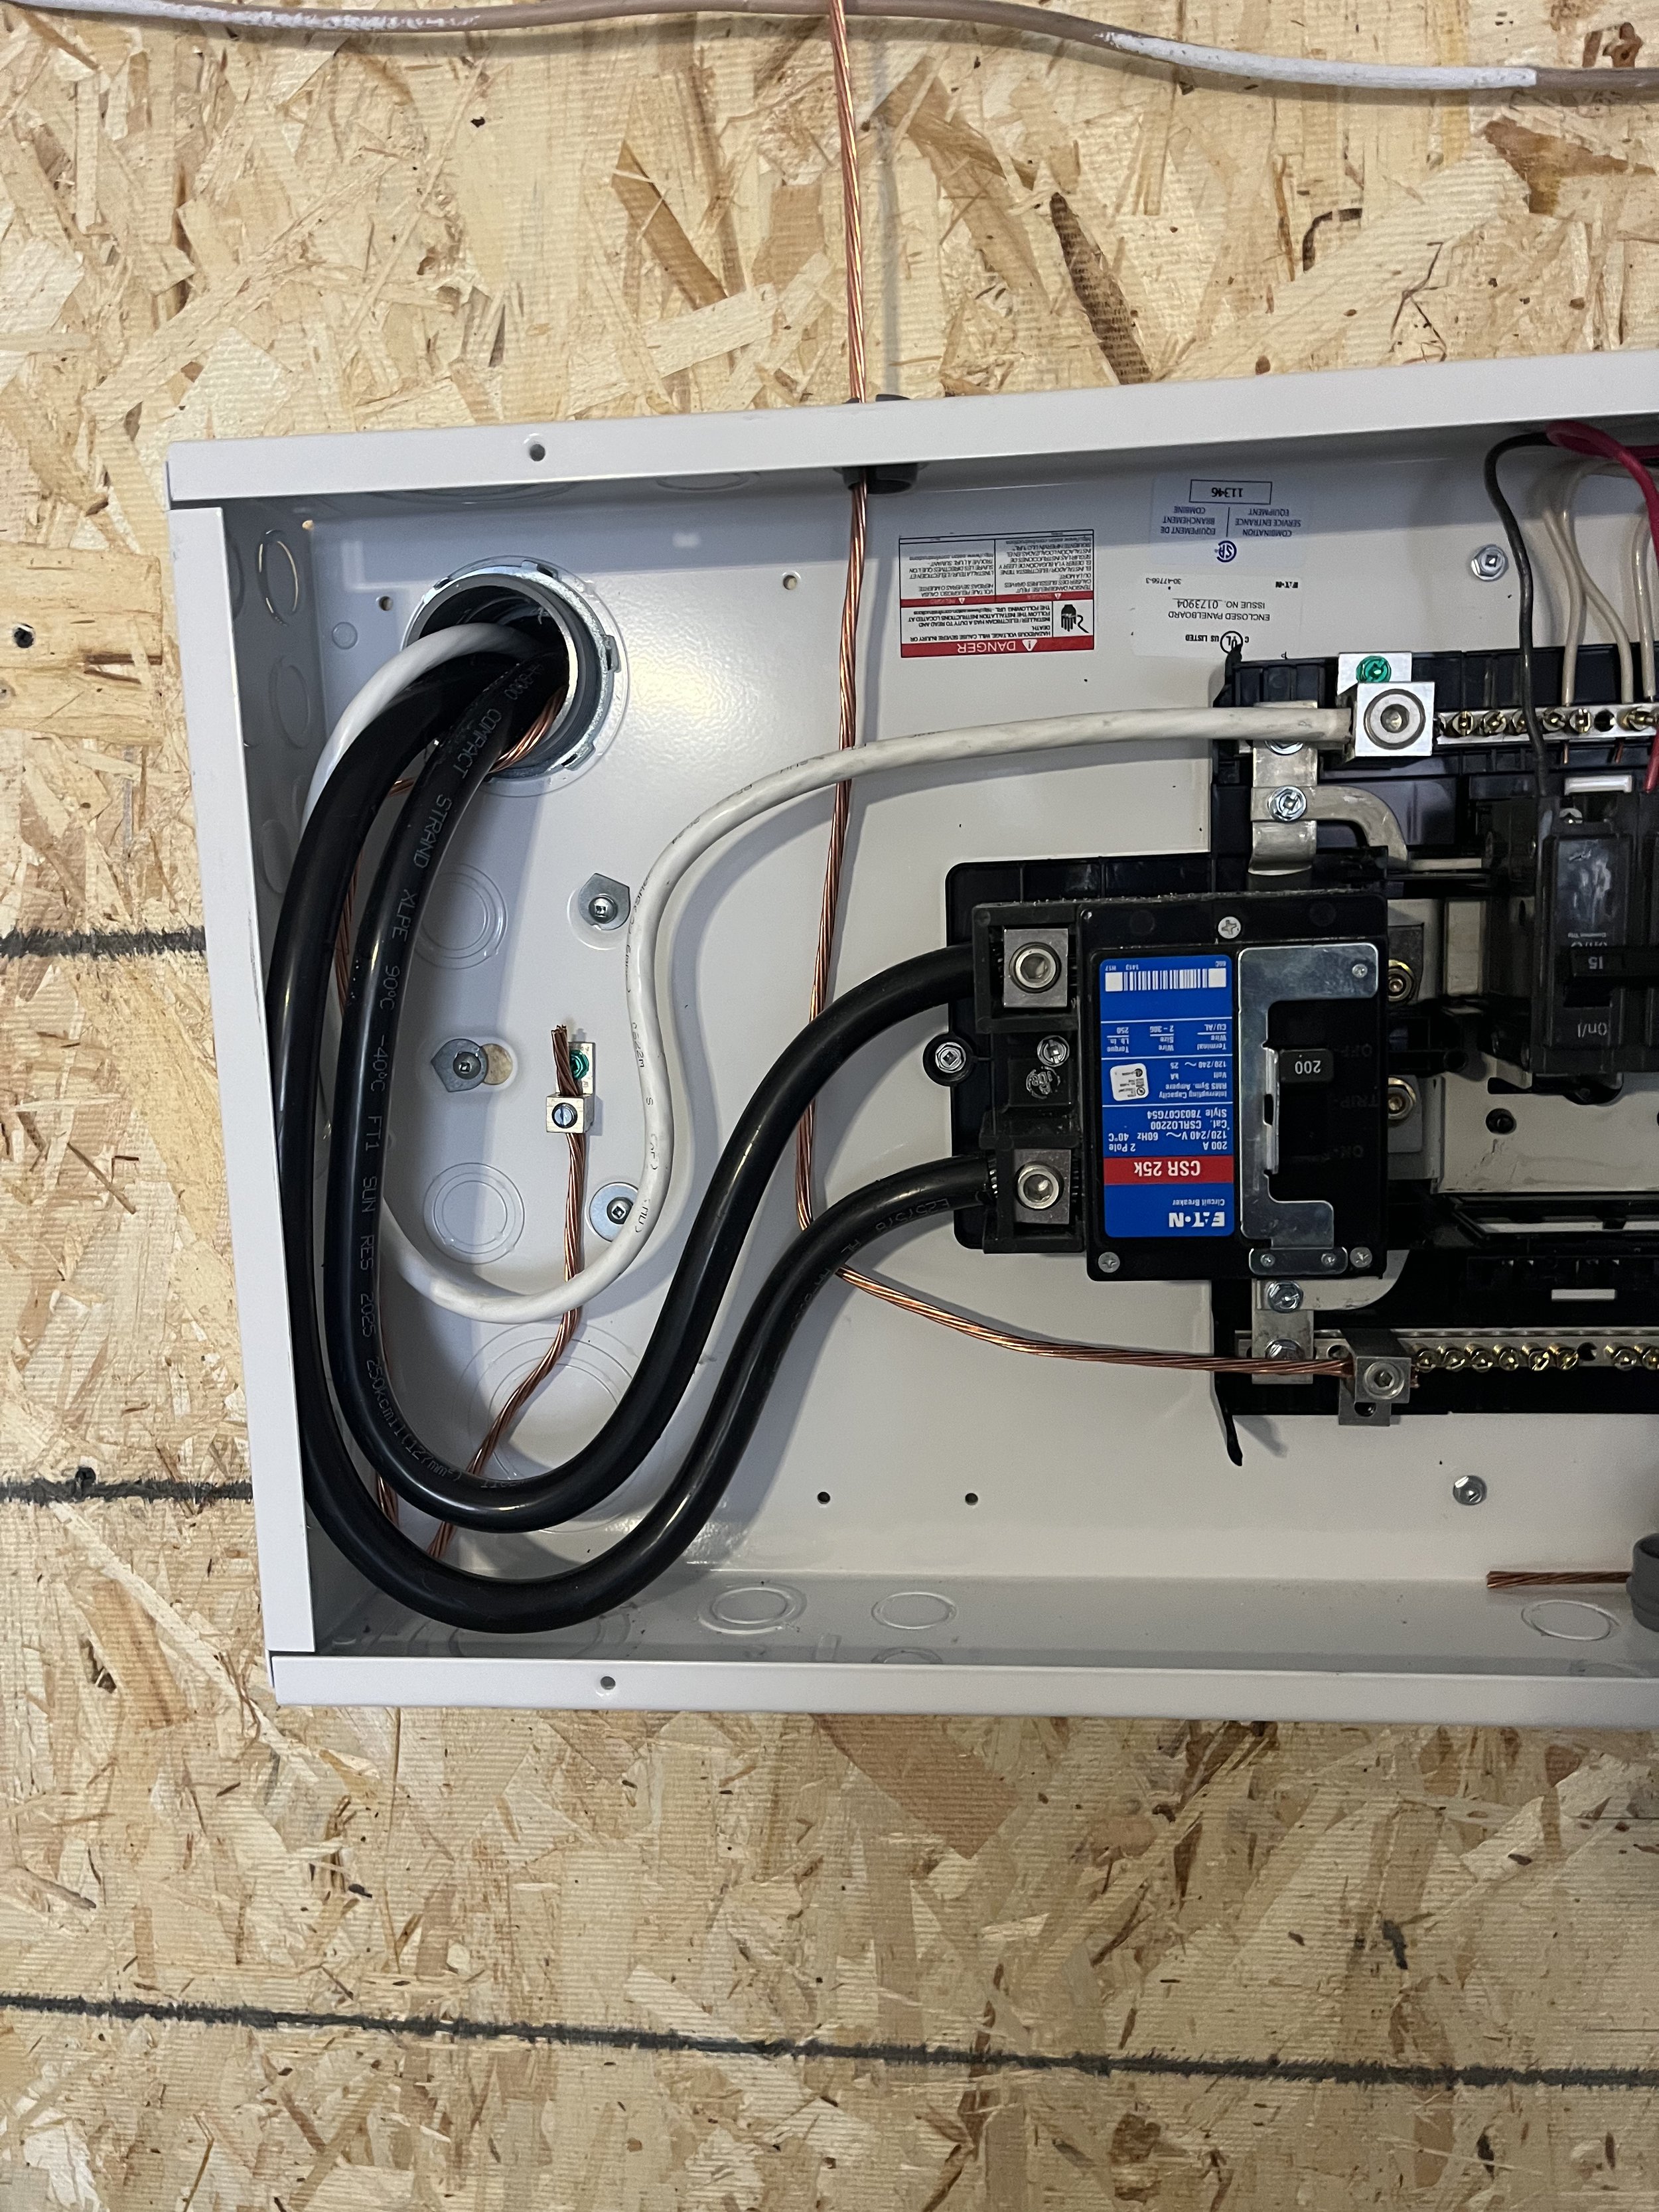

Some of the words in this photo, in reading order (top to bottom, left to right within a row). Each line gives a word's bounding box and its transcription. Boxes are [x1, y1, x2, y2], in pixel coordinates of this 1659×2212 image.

[1211, 487, 1244, 498] 11346
[1248, 508, 1289, 517] EQUIPMENT
[1163, 516, 1215, 525] BRANCHEMENT
[1171, 526, 1216, 535] EQUIPEMENT
[1242, 528, 1292, 538] COMBINATION
[1177, 599, 1218, 609] 0173904
[1225, 612, 1270, 621] ENCLOSED
[957, 640, 1016, 653] DANGER
[453, 708, 502, 779] COMPACT
[413, 794, 451, 869] STRAND
[391, 889, 417, 942] XLPE
[1588, 956, 1603, 970] 15
[1294, 1060, 1322, 1074] 200
[1165, 1082, 1191, 1090] Ampere
[1159, 1090, 1187, 1099] Capacity
[1189, 1089, 1227, 1098] Interrupting
[1205, 1107, 1227, 1118] Style
[1210, 1120, 1227, 1129] Cat.
[365, 1116, 384, 1151] FT1
[1137, 1132, 1159, 1141] 60Hz
[1190, 1130, 1227, 1140] 120/240
[1109, 1143, 1127, 1152] Pole
[1130, 1143, 1135, 1151] 2
[1202, 1142, 1209, 1150] A
[1212, 1141, 1227, 1150] 200
[1133, 1161, 1162, 1177] 25k
[1168, 1160, 1200, 1176] CSR
[361, 1177, 378, 1213] SUN
[1169, 1212, 1225, 1227] EATON
[840, 1238, 861, 1254] AL
[359, 1235, 376, 1271] RES
[359, 1291, 376, 1339] 2025
